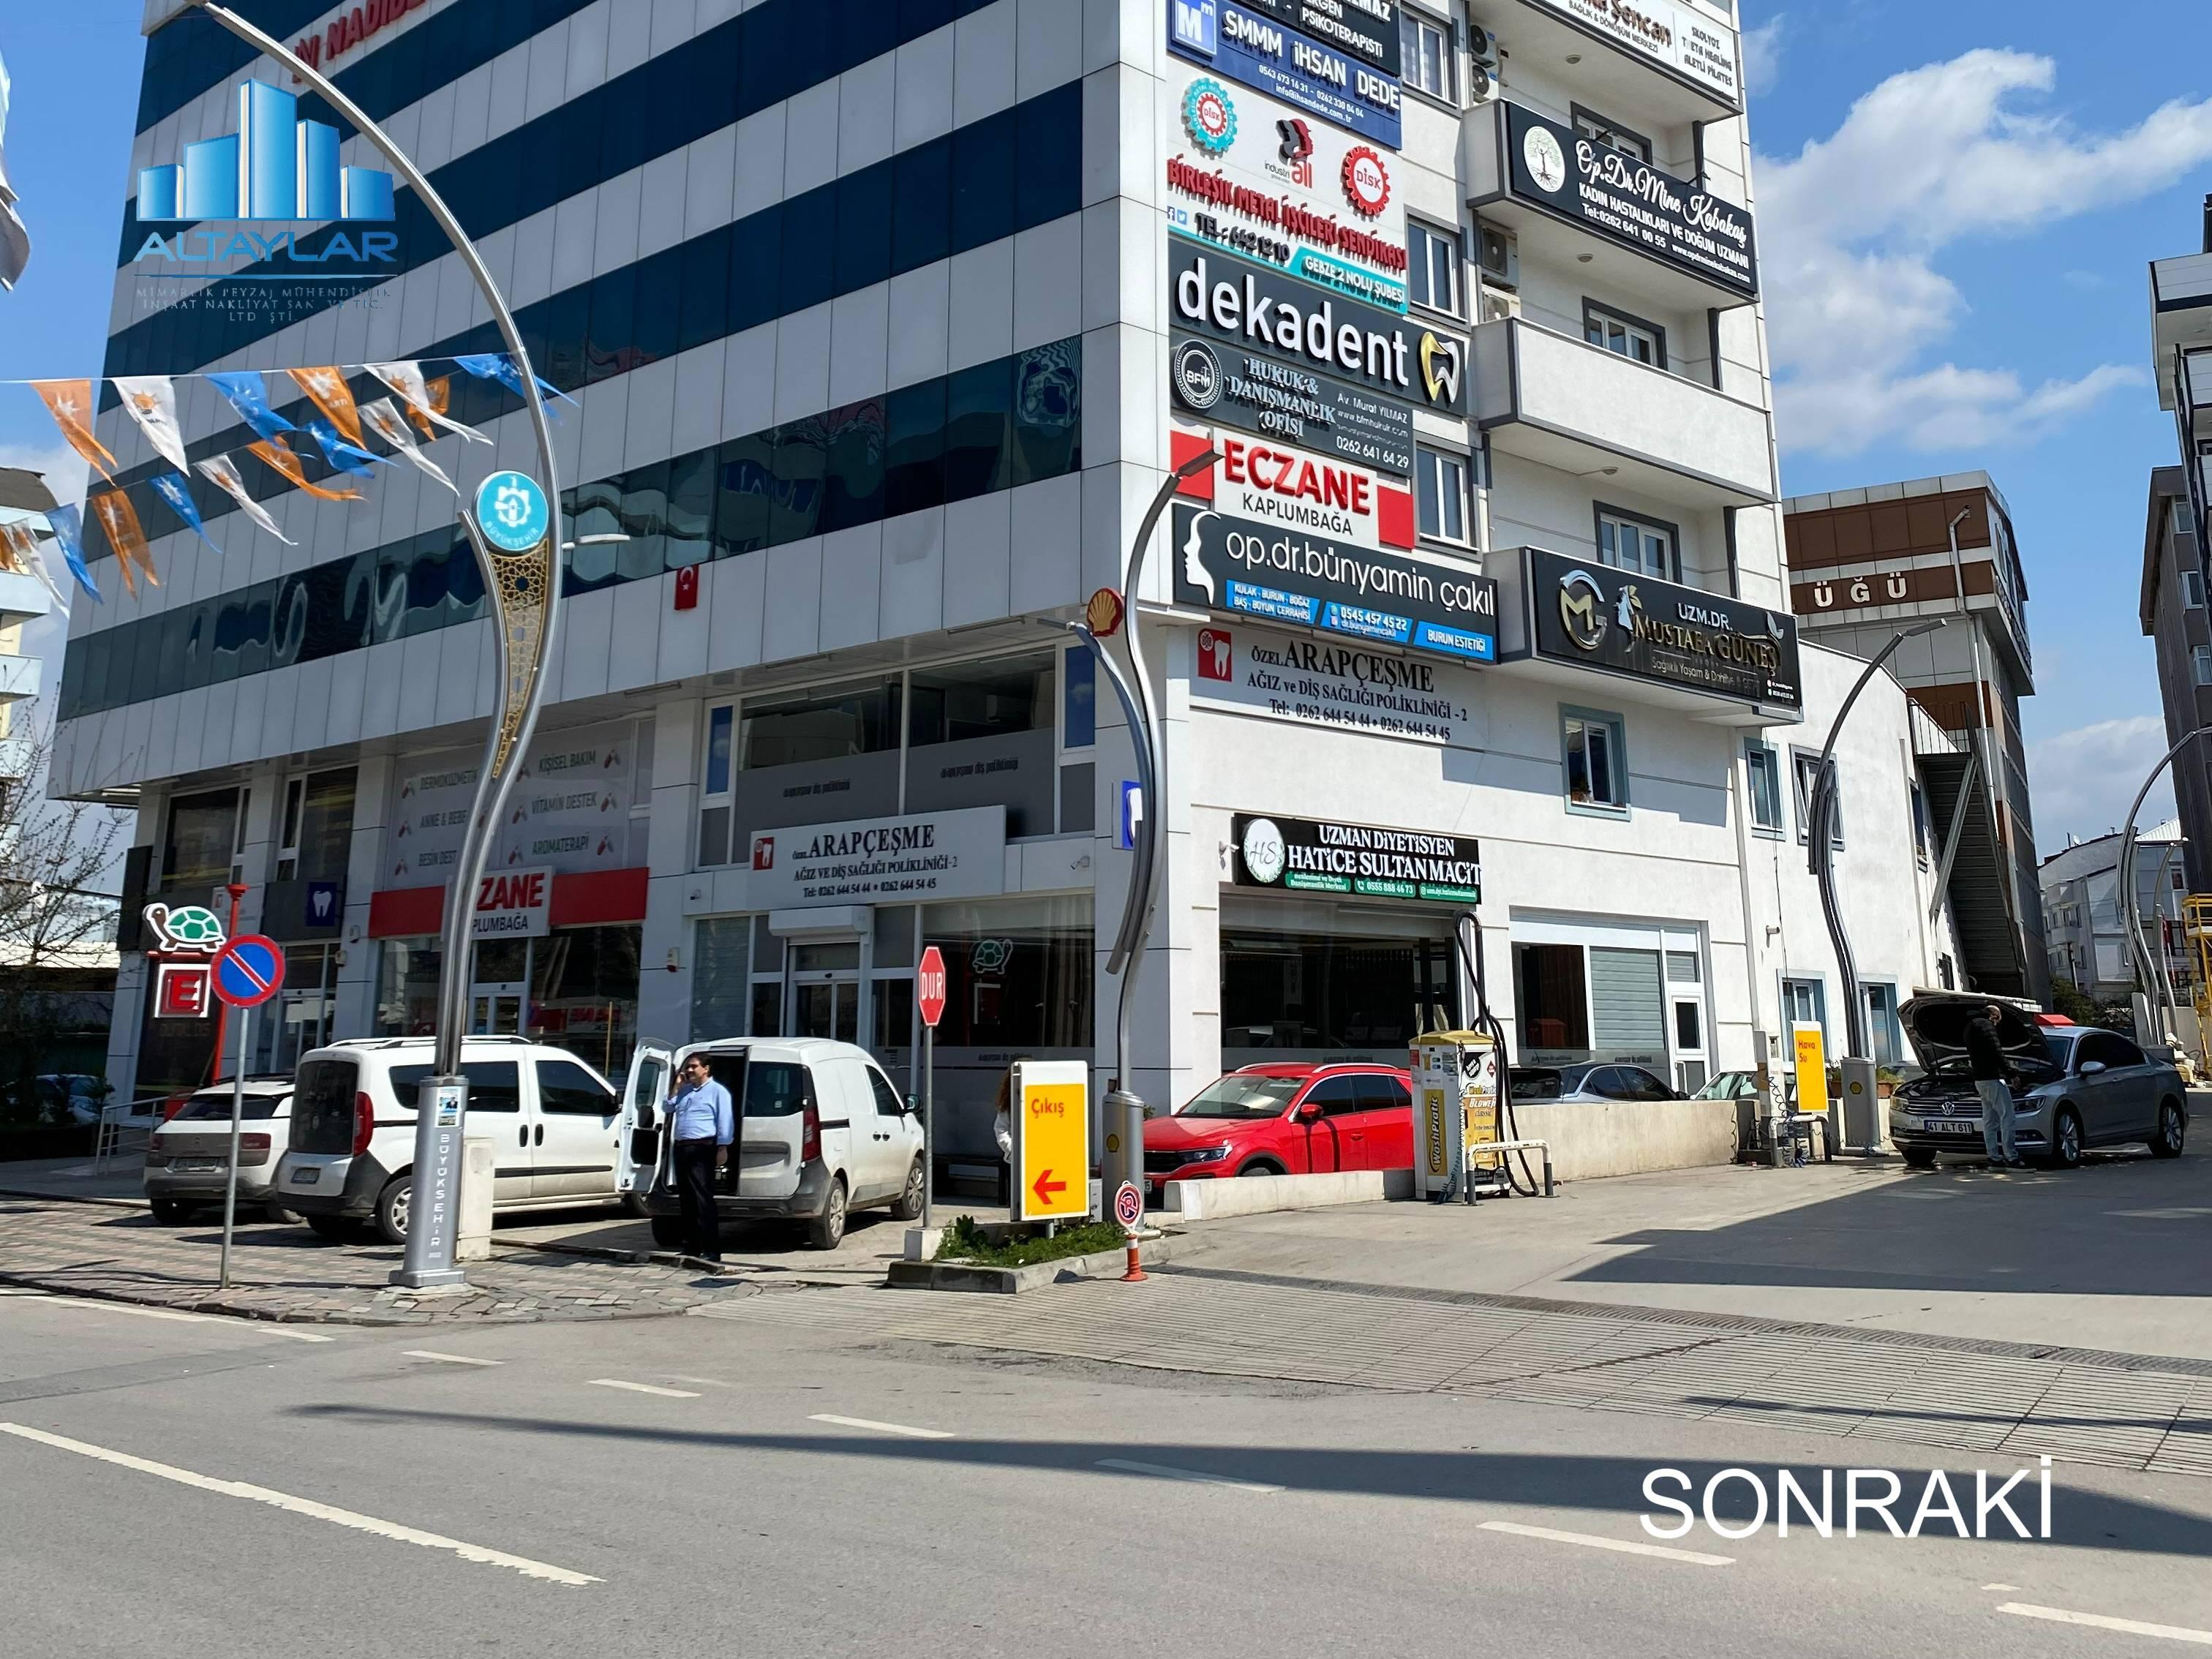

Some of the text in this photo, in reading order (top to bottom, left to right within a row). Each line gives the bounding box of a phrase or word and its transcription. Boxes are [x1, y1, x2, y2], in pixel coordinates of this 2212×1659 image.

[1224, 10, 1282, 58] SMMM
[1358, 69, 1401, 111] DEDE
[1276, 83, 1353, 123] info@ihsandede.com.tr
[1277, 73, 1290, 85] 673
[1291, 79, 1299, 89] 16
[1300, 83, 1308, 94] 31
[1317, 91, 1333, 105] 0262
[1347, 103, 1355, 113] 04
[1355, 108, 1364, 118] 04
[1355, 167, 1382, 191] DİSK
[1167, 153, 1234, 206] BİRLEŞİK
[1234, 184, 1282, 223] METAL
[1339, 226, 1407, 271] SENDİKASI
[1579, 183, 1749, 269] KADIN HASTALIKLARI VE DOĞUM UZMANI
[1623, 219, 1639, 237] 641
[1641, 227, 1653, 243] 00
[1655, 233, 1666, 249] 55
[1304, 256, 1336, 279] GEBZE
[1336, 267, 1344, 282] 2
[1347, 271, 1372, 292] NOLU
[1178, 257, 1409, 387] dekadent
[1186, 370, 1211, 389] BFM
[1246, 357, 1306, 388] HUKUK
[1306, 375, 1319, 395] &
[1230, 375, 1336, 425] DANIŞMANLIK
[1336, 435, 1361, 454] 0262
[1363, 444, 1380, 460] 641
[1382, 450, 1395, 464] 64
[1397, 454, 1409, 469] 29
[1223, 438, 1372, 516] ECZANE
[1242, 492, 1353, 536] KAPLUMBAĞA
[1233, 596, 1248, 609] BAŞ
[1252, 600, 1275, 613] BOYUN
[1234, 583, 1310, 608] KULAK BURUN BOĞAZ
[1440, 576, 1494, 616] çakıl
[1340, 606, 1363, 622] 0545
[1364, 613, 1381, 625] 457
[1383, 617, 1394, 629] 45
[1396, 619, 1407, 631] 22
[1427, 629, 1454, 646] BURUN
[1252, 640, 1434, 693] ÖZEL ARAPÇEŞME
[1247, 669, 1467, 722] AĞIZ ve DİŞ SAĞLIĞI POLİKLİNİĞİ 2
[1269, 698, 1451, 741] Tel: 0262 644 54 44 0262 644 54 45
[568, 749, 597, 768] BAKIM
[565, 791, 598, 808] DESTEK
[808, 824, 935, 858] ARAPÇEŞME
[1319, 824, 1374, 849] UZMAN
[794, 865, 816, 881] AĞIZ
[818, 867, 830, 879] VE
[831, 864, 846, 880] DİŞ
[847, 860, 886, 878] SAĞLIĞI
[1287, 845, 1357, 874] HATİCE
[1359, 852, 1429, 881] SULTAN
[476, 872, 546, 912] ZANE
[819, 885, 835, 897] 0262
[836, 884, 849, 895] 644
[881, 880, 898, 892] 0262
[900, 879, 914, 890] 644
[915, 879, 925, 889] 54
[926, 878, 936, 889] 45
[1366, 881, 1382, 891] 0555
[1396, 884, 1404, 893] 46
[1405, 884, 1413, 894] 73
[473, 912, 529, 933] PLUMBAĞA
[920, 972, 943, 1001] DUR
[1798, 1040, 1816, 1050] Hava
[1799, 1053, 1807, 1063] Su
[1031, 1097, 1065, 1118] Çıkış
[1929, 1122, 1971, 1132] 41 ALT 611
